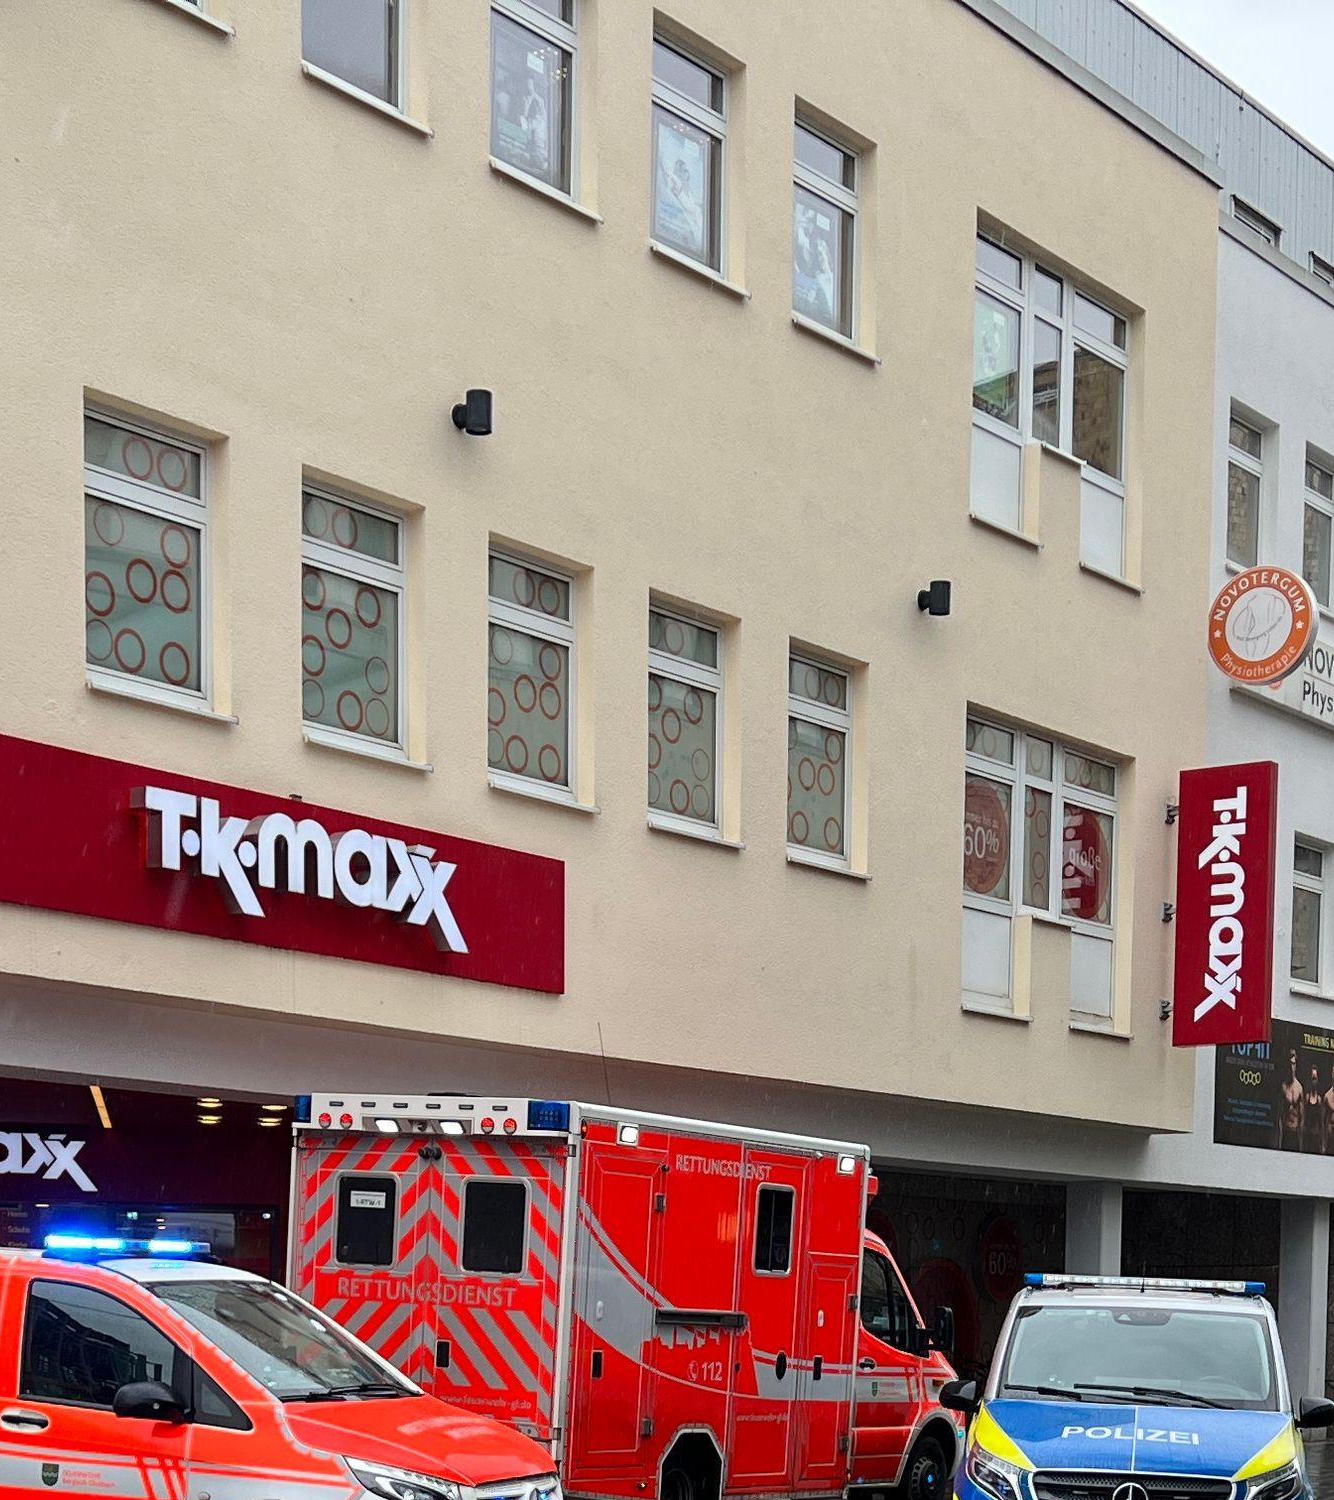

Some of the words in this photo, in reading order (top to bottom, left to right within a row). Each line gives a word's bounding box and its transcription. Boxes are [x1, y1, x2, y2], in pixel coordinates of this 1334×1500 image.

[1213, 571, 1306, 622] NOVOTERGUM
[1221, 645, 1297, 678] Physiotherapie
[964, 822, 999, 859] 60%
[675, 1153, 772, 1181] RETTUNGSDIENST
[338, 1277, 516, 1307] RETTUNGSDIENST
[701, 1361, 723, 1382] 112
[1061, 1426, 1200, 1446] POLIZEI
